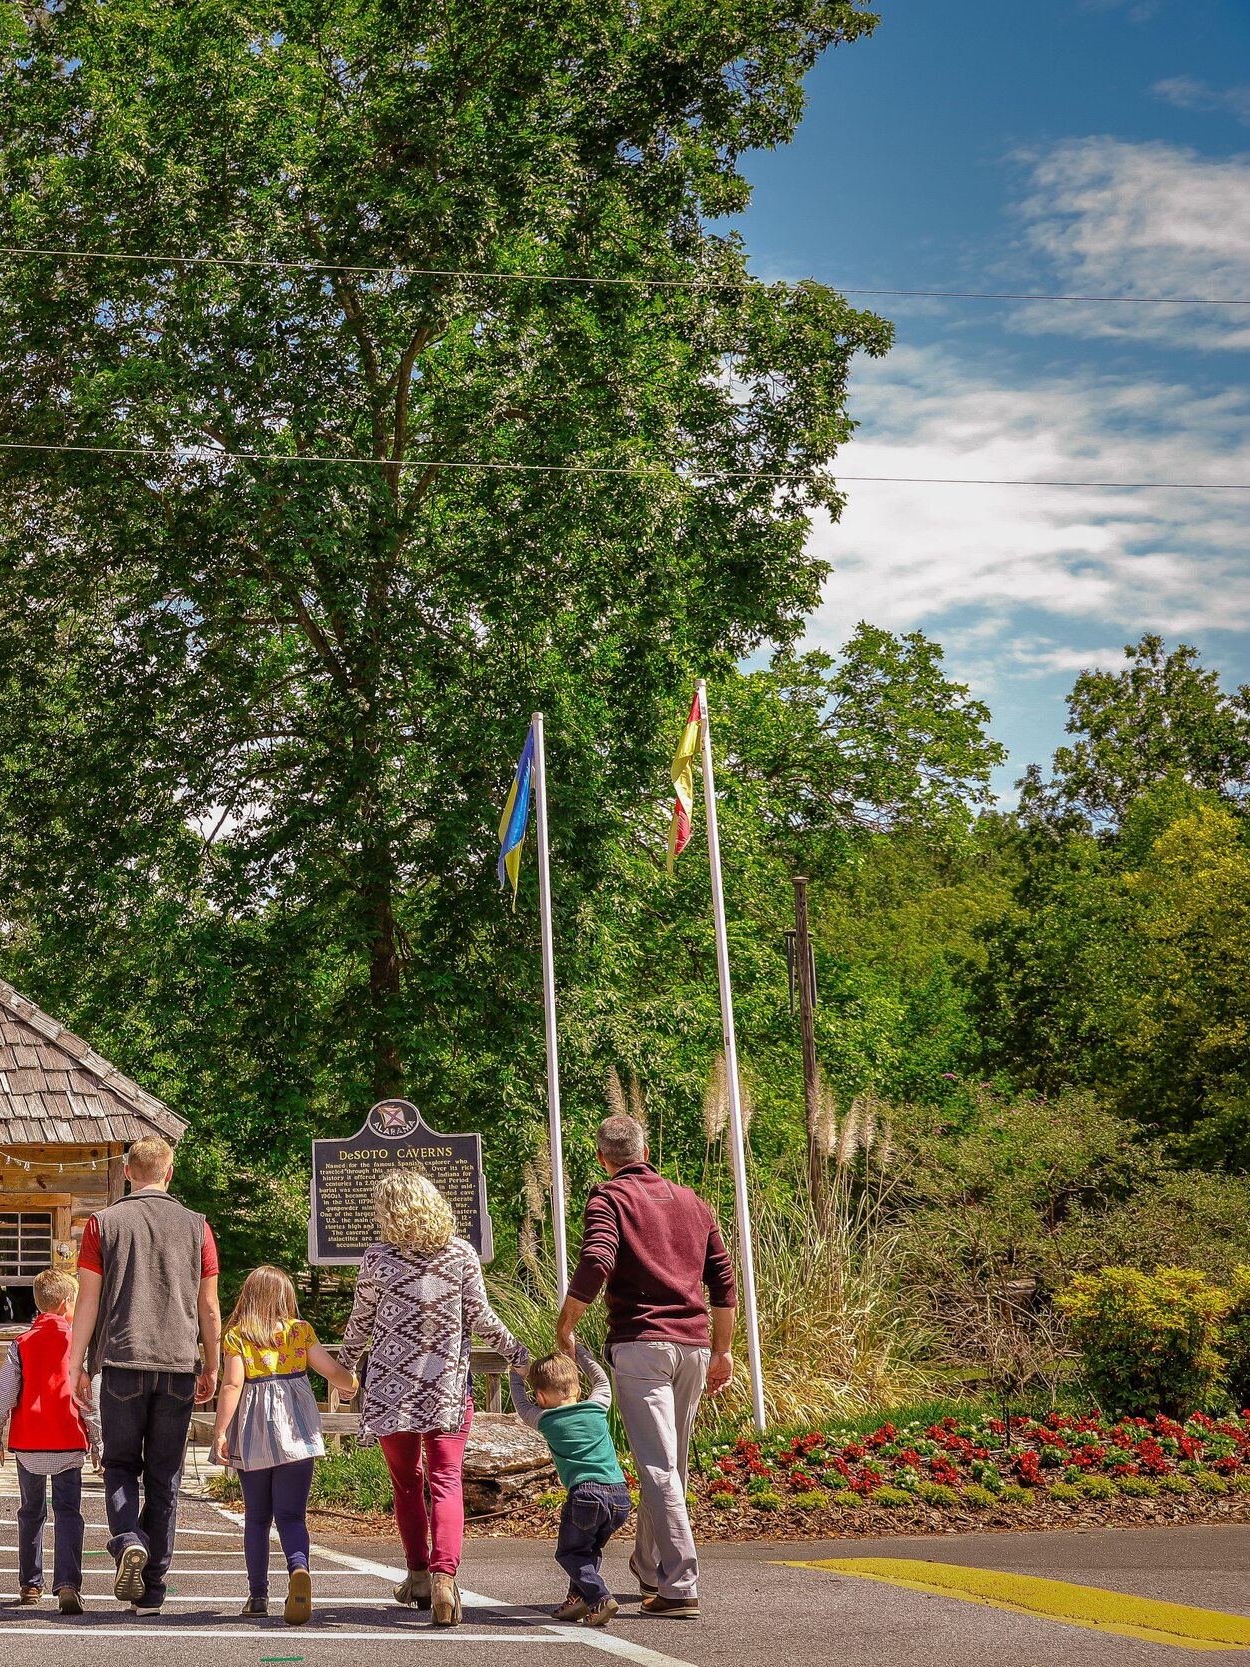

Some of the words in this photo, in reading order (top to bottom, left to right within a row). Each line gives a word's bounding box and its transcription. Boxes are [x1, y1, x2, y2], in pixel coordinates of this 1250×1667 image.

[372, 1120, 416, 1136] ALABAMA
[339, 1149, 388, 1160] DeSOTO
[396, 1147, 453, 1158] CAVERNS
